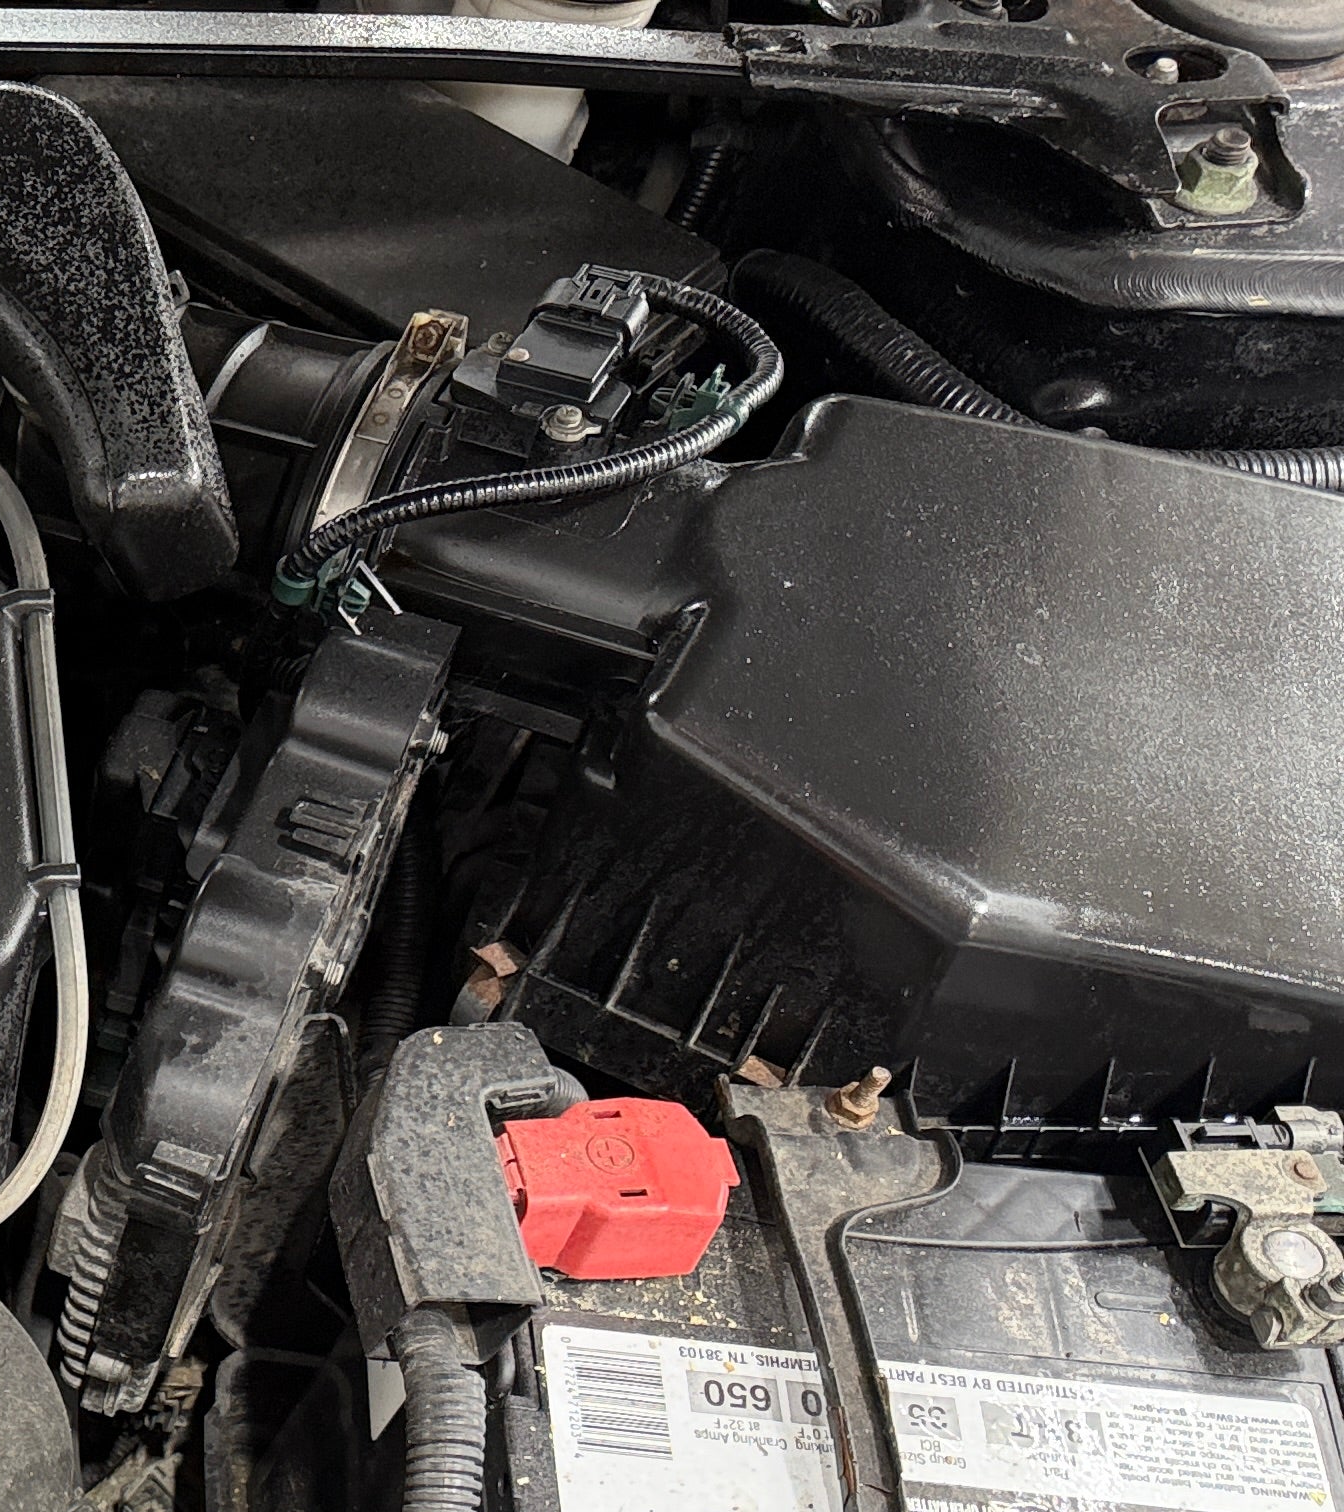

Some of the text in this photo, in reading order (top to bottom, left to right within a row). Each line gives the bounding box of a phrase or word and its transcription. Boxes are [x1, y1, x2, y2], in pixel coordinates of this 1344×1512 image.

[678, 1346, 723, 1362] 38103
[728, 1351, 747, 1365] TN
[929, 1372, 966, 1388] BEST
[972, 1377, 991, 1390] BY
[703, 1380, 771, 1412] 650
[907, 1403, 947, 1430] 35
[748, 1421, 760, 1431] at
[1247, 1425, 1312, 1439] reproductive
[694, 1429, 788, 1450] Cranking Amps
[795, 1438, 832, 1454] nking
[920, 1439, 941, 1451] BCI
[929, 1452, 966, 1470] Group
[1164, 1457, 1217, 1470] chmicals
[1271, 1457, 1291, 1468] and
[1043, 1466, 1069, 1480] Part
[1155, 1475, 1191, 1489] battery
[1250, 1486, 1311, 1501] WARNING
